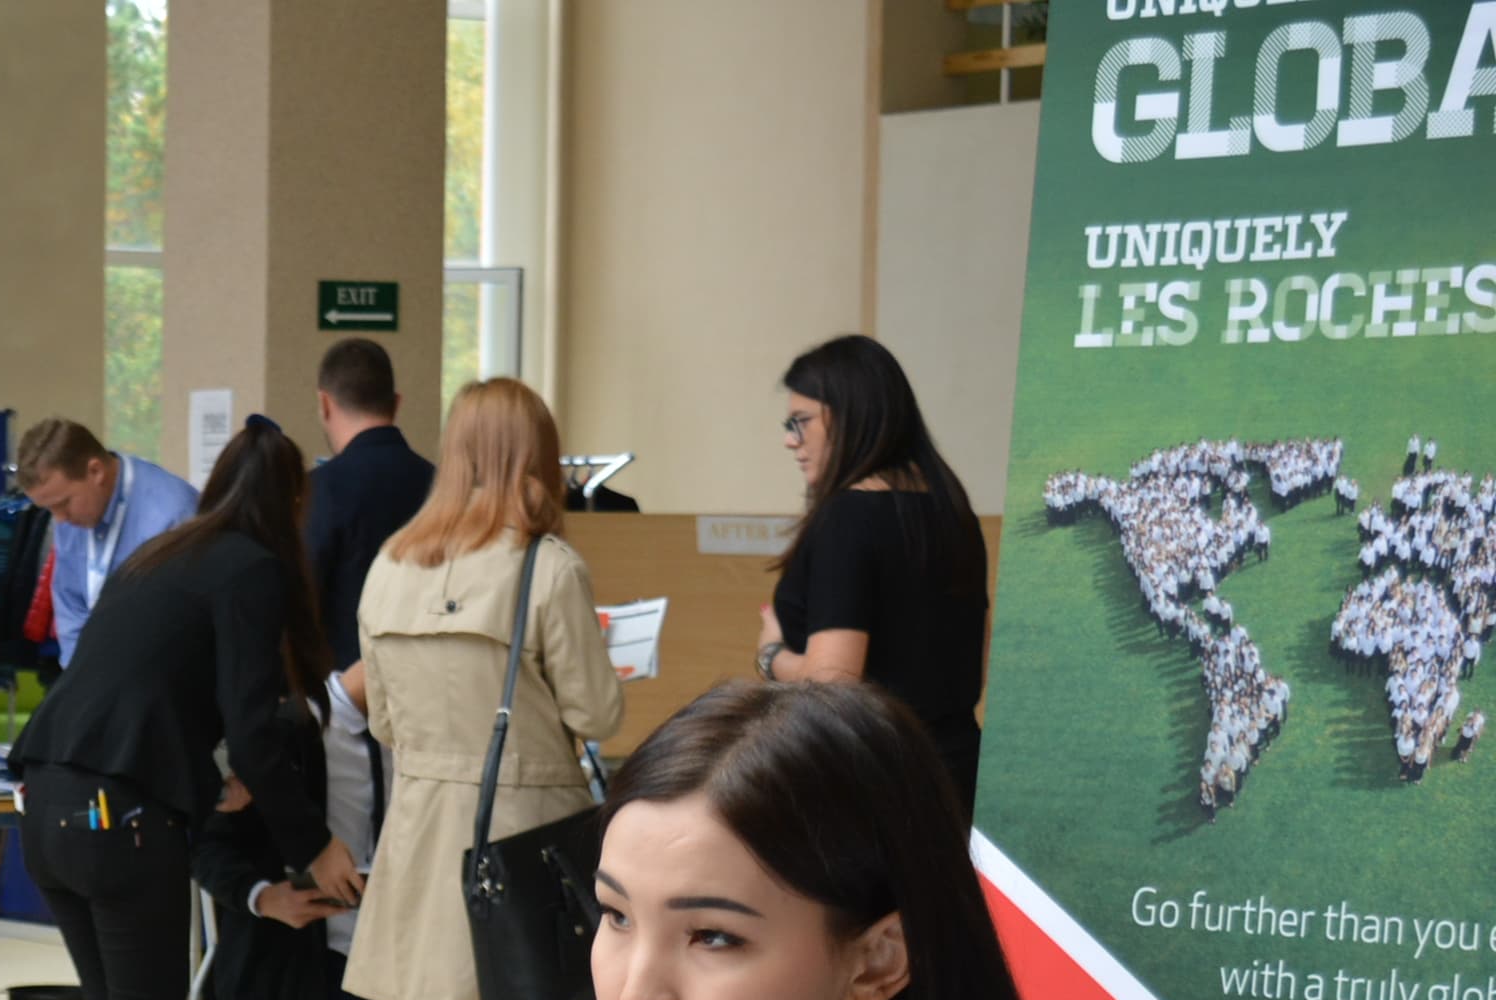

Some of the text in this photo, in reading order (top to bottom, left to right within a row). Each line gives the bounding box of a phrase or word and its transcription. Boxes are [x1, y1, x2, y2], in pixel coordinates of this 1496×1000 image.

[1084, 212, 1348, 270] UNIQUELY
[336, 286, 378, 306] EXIT
[1074, 263, 1496, 348] LES ROCHES
[1131, 886, 1481, 960] Go further than you
[1219, 959, 1296, 1000] with
